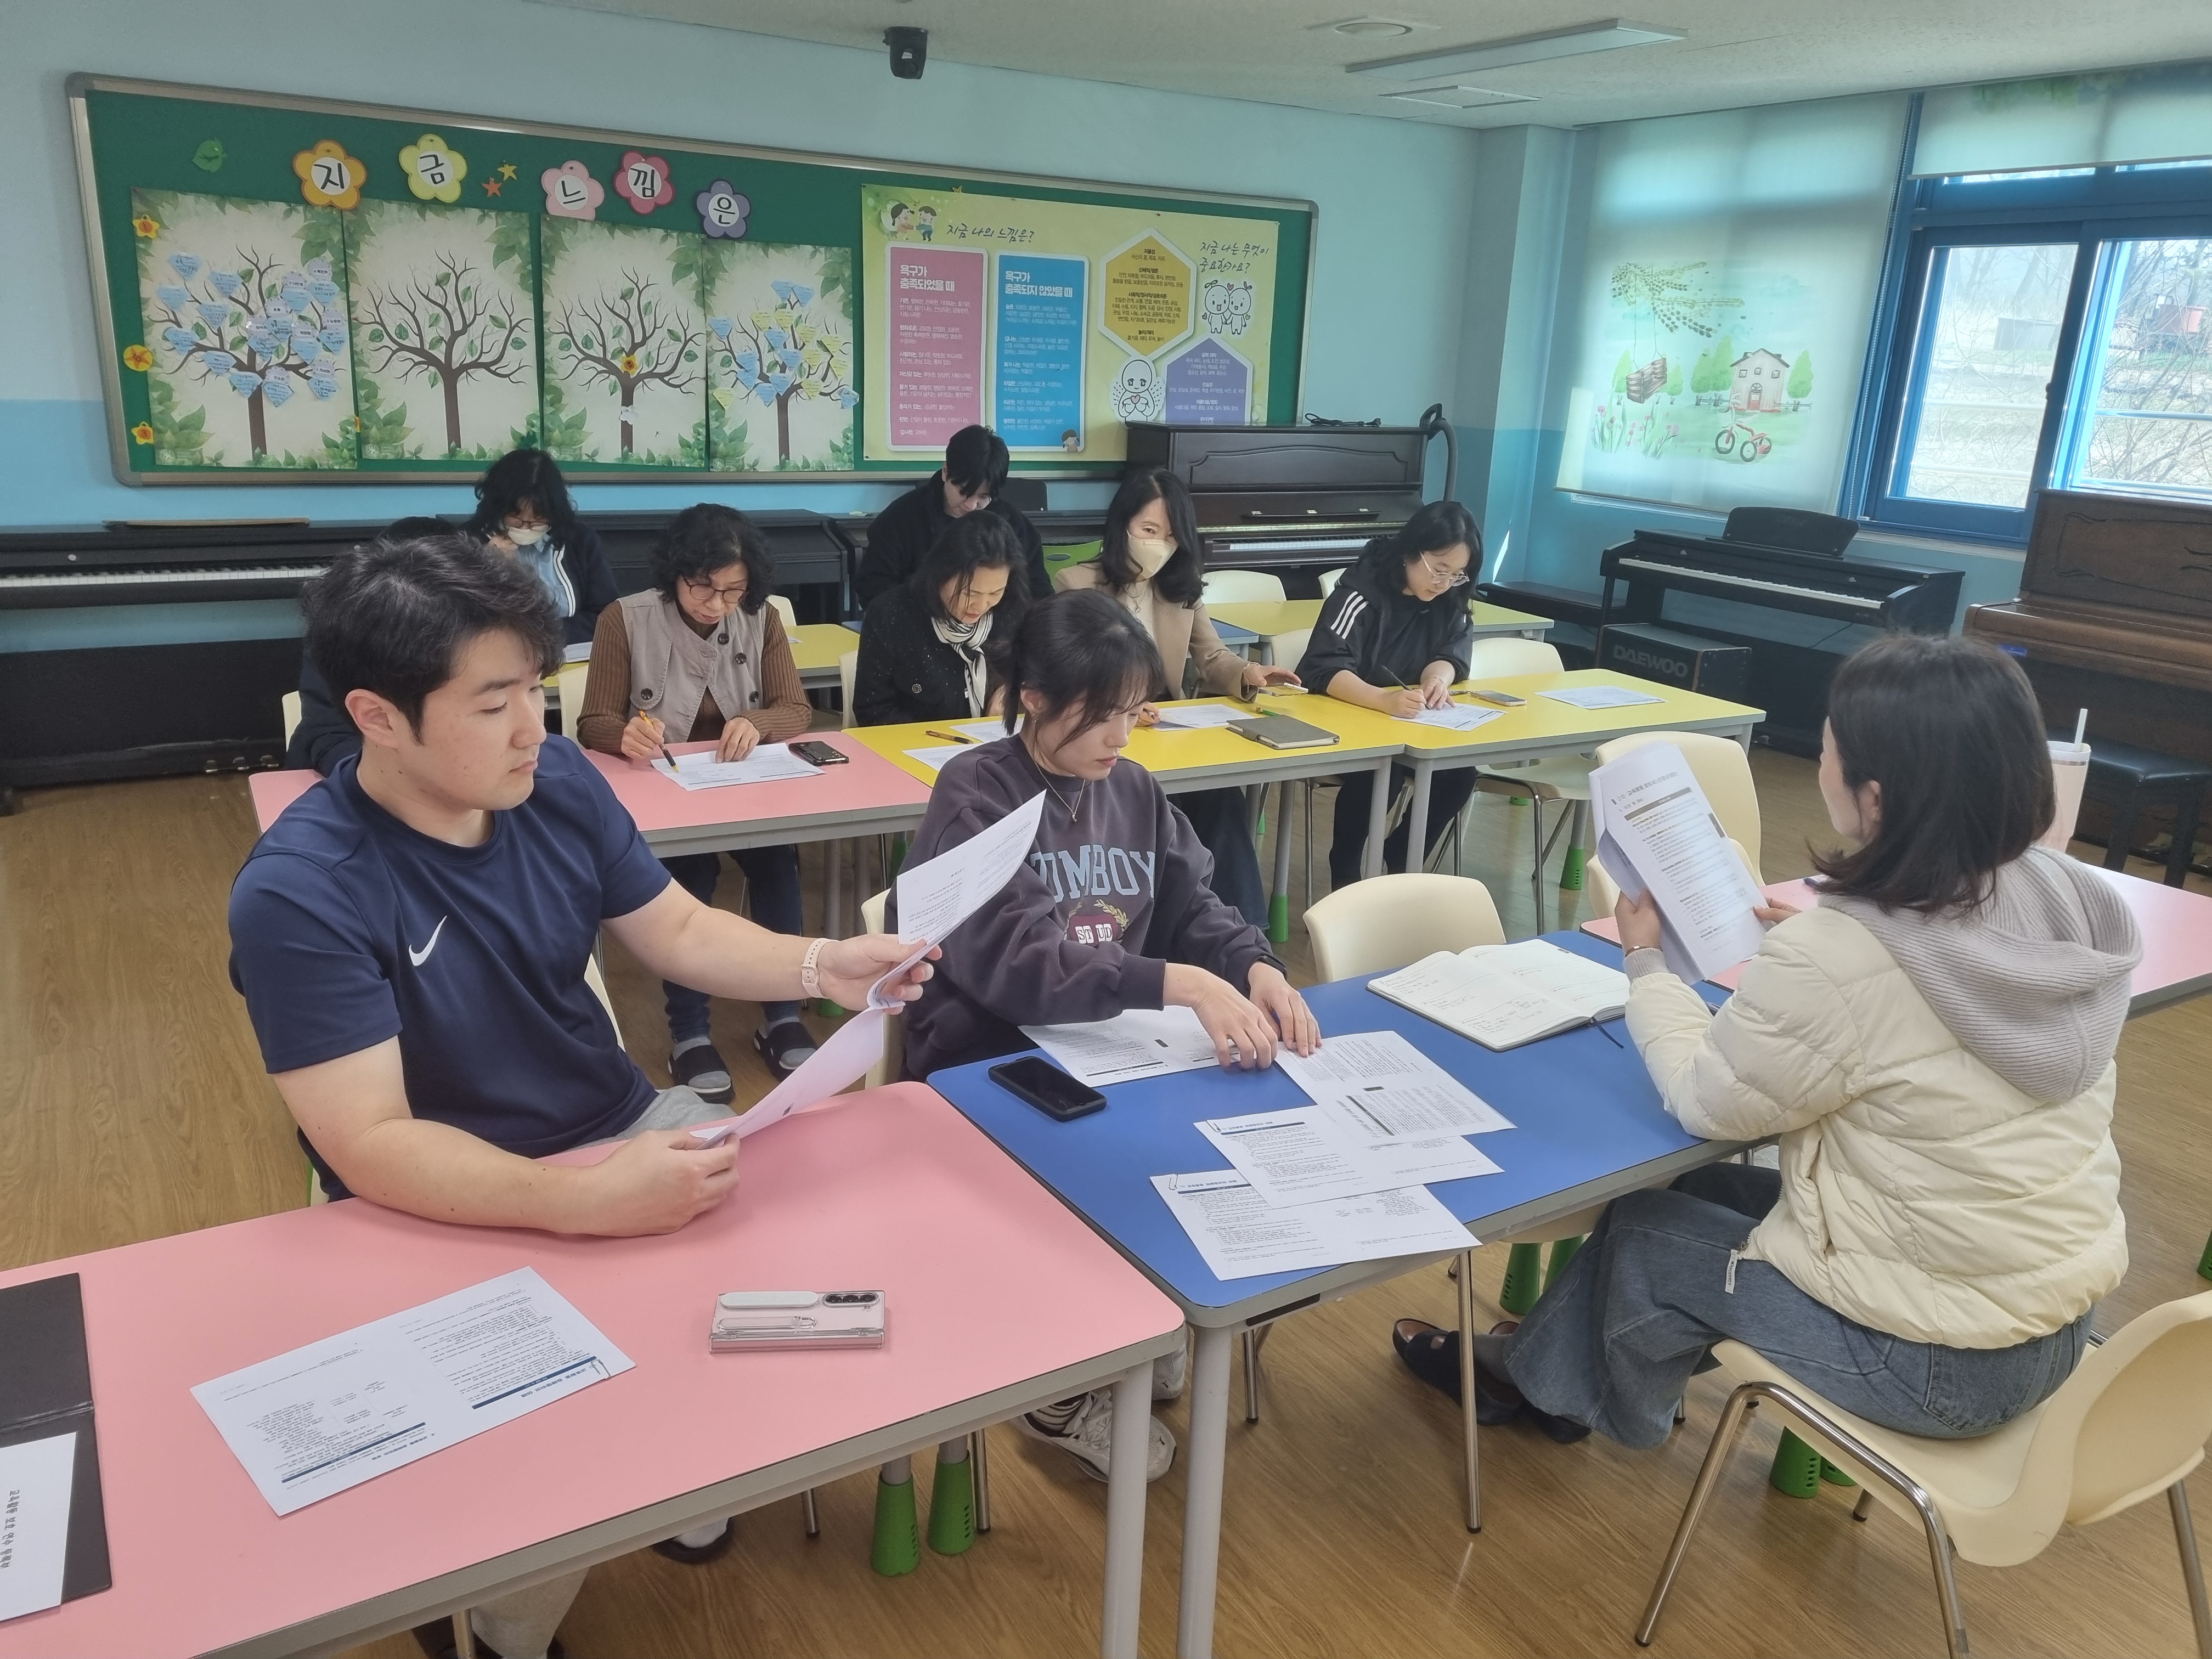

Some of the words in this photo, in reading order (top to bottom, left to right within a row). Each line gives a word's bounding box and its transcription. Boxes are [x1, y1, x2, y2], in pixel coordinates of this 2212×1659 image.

[314, 163, 345, 190] 지
[419, 154, 444, 185] 금
[561, 180, 586, 204] 느
[630, 168, 655, 199] 낌
[712, 196, 736, 225] 은
[946, 223, 968, 239] 지금
[972, 227, 994, 237] 나의
[997, 227, 1035, 243] 느낌은?
[1200, 240, 1218, 255] 지금
[1221, 242, 1239, 255] 나는
[1242, 243, 1269, 259] 무엇이
[900, 264, 927, 277] 욕구가
[1200, 257, 1250, 274] 중요한가요?
[900, 278, 944, 291] 충족되었을
[945, 280, 955, 292] 때
[1006, 270, 1030, 283] 욕구가
[1005, 284, 1037, 296] 충족되지
[1039, 285, 1063, 297] 않았을
[1064, 287, 1073, 297] 때
[1613, 645, 1688, 678] DAEWOO
[7, 1489, 20, 1514] 교육활동
[4, 1517, 16, 1531] 보호
[2, 1532, 14, 1545] 연수
